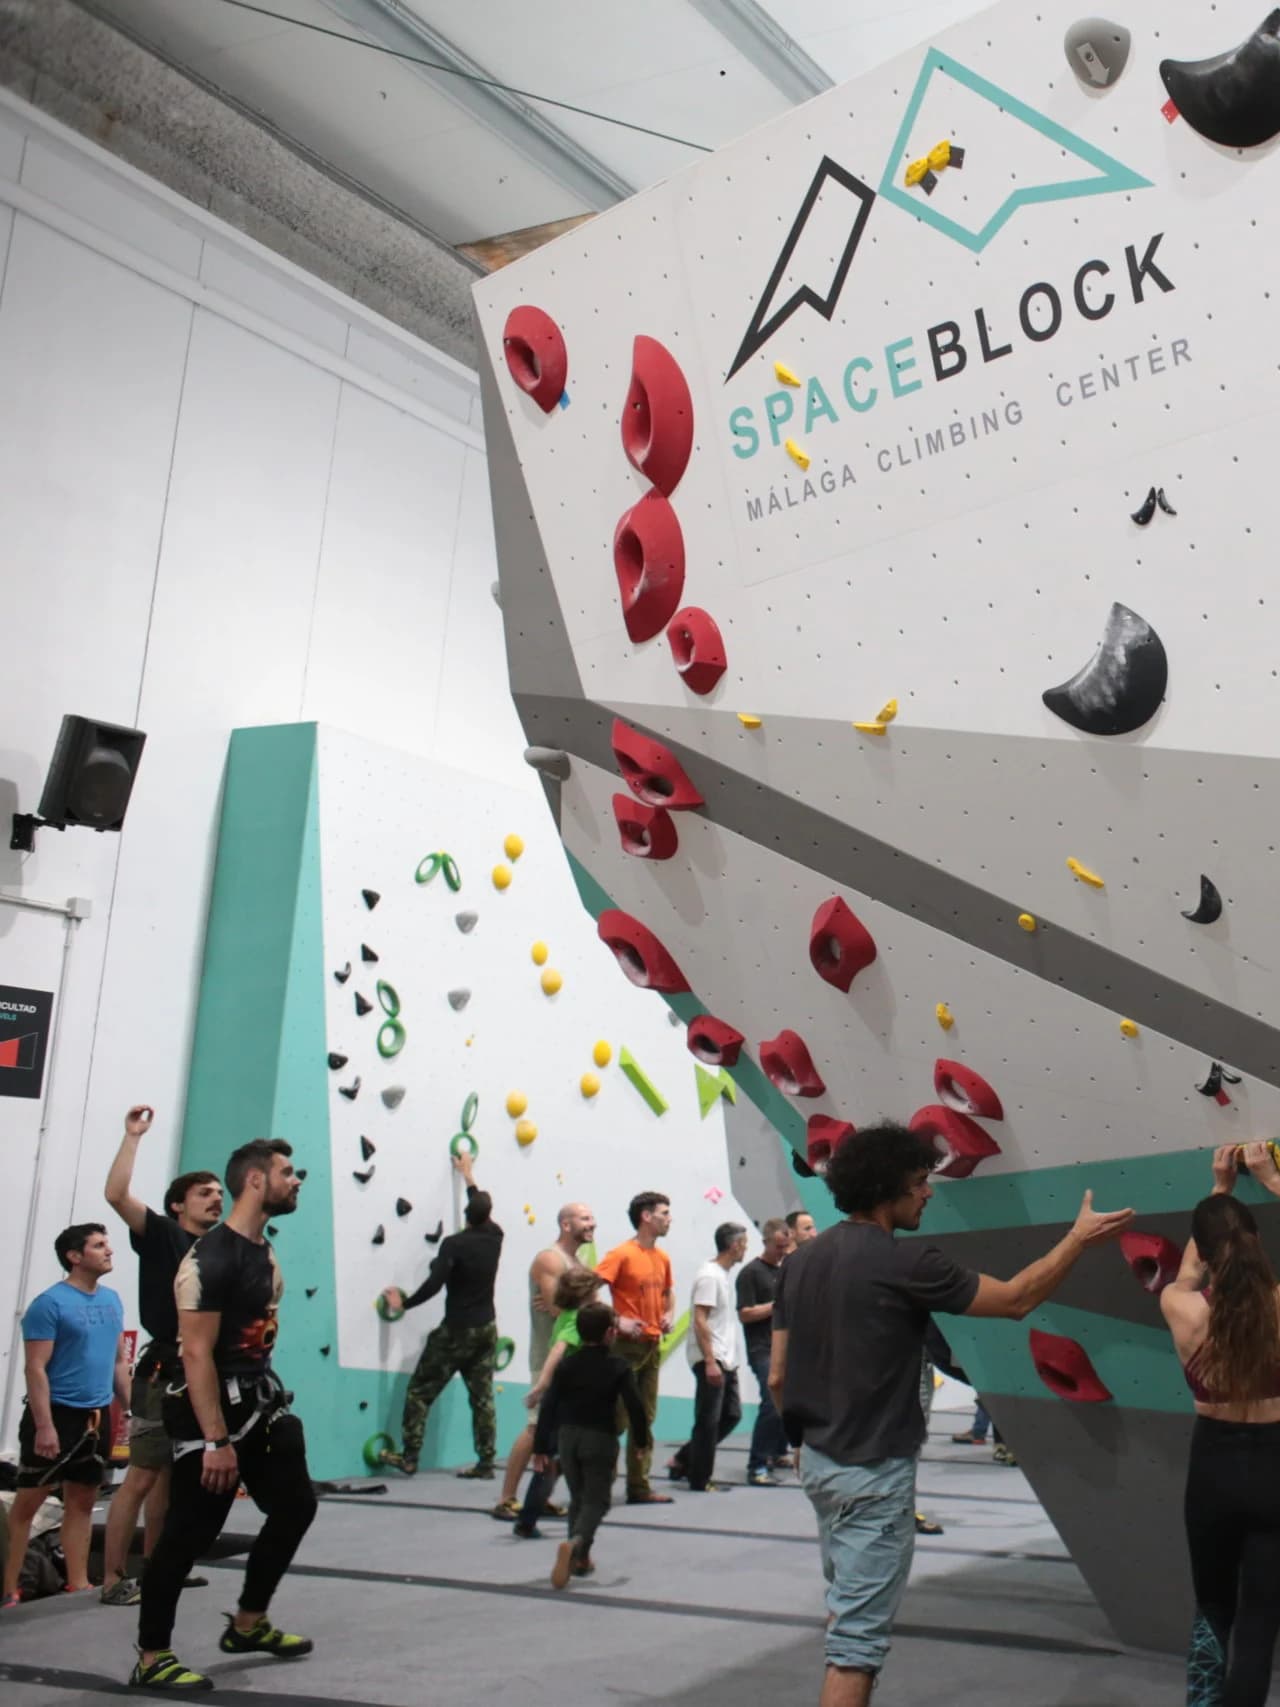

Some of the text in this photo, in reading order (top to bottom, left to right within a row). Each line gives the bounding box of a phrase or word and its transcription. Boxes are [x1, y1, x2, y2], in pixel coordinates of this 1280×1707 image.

[728, 232, 1176, 459] SPACEBLOCK
[745, 338, 1193, 522] MÁLAGA CLIMBING CENTER
